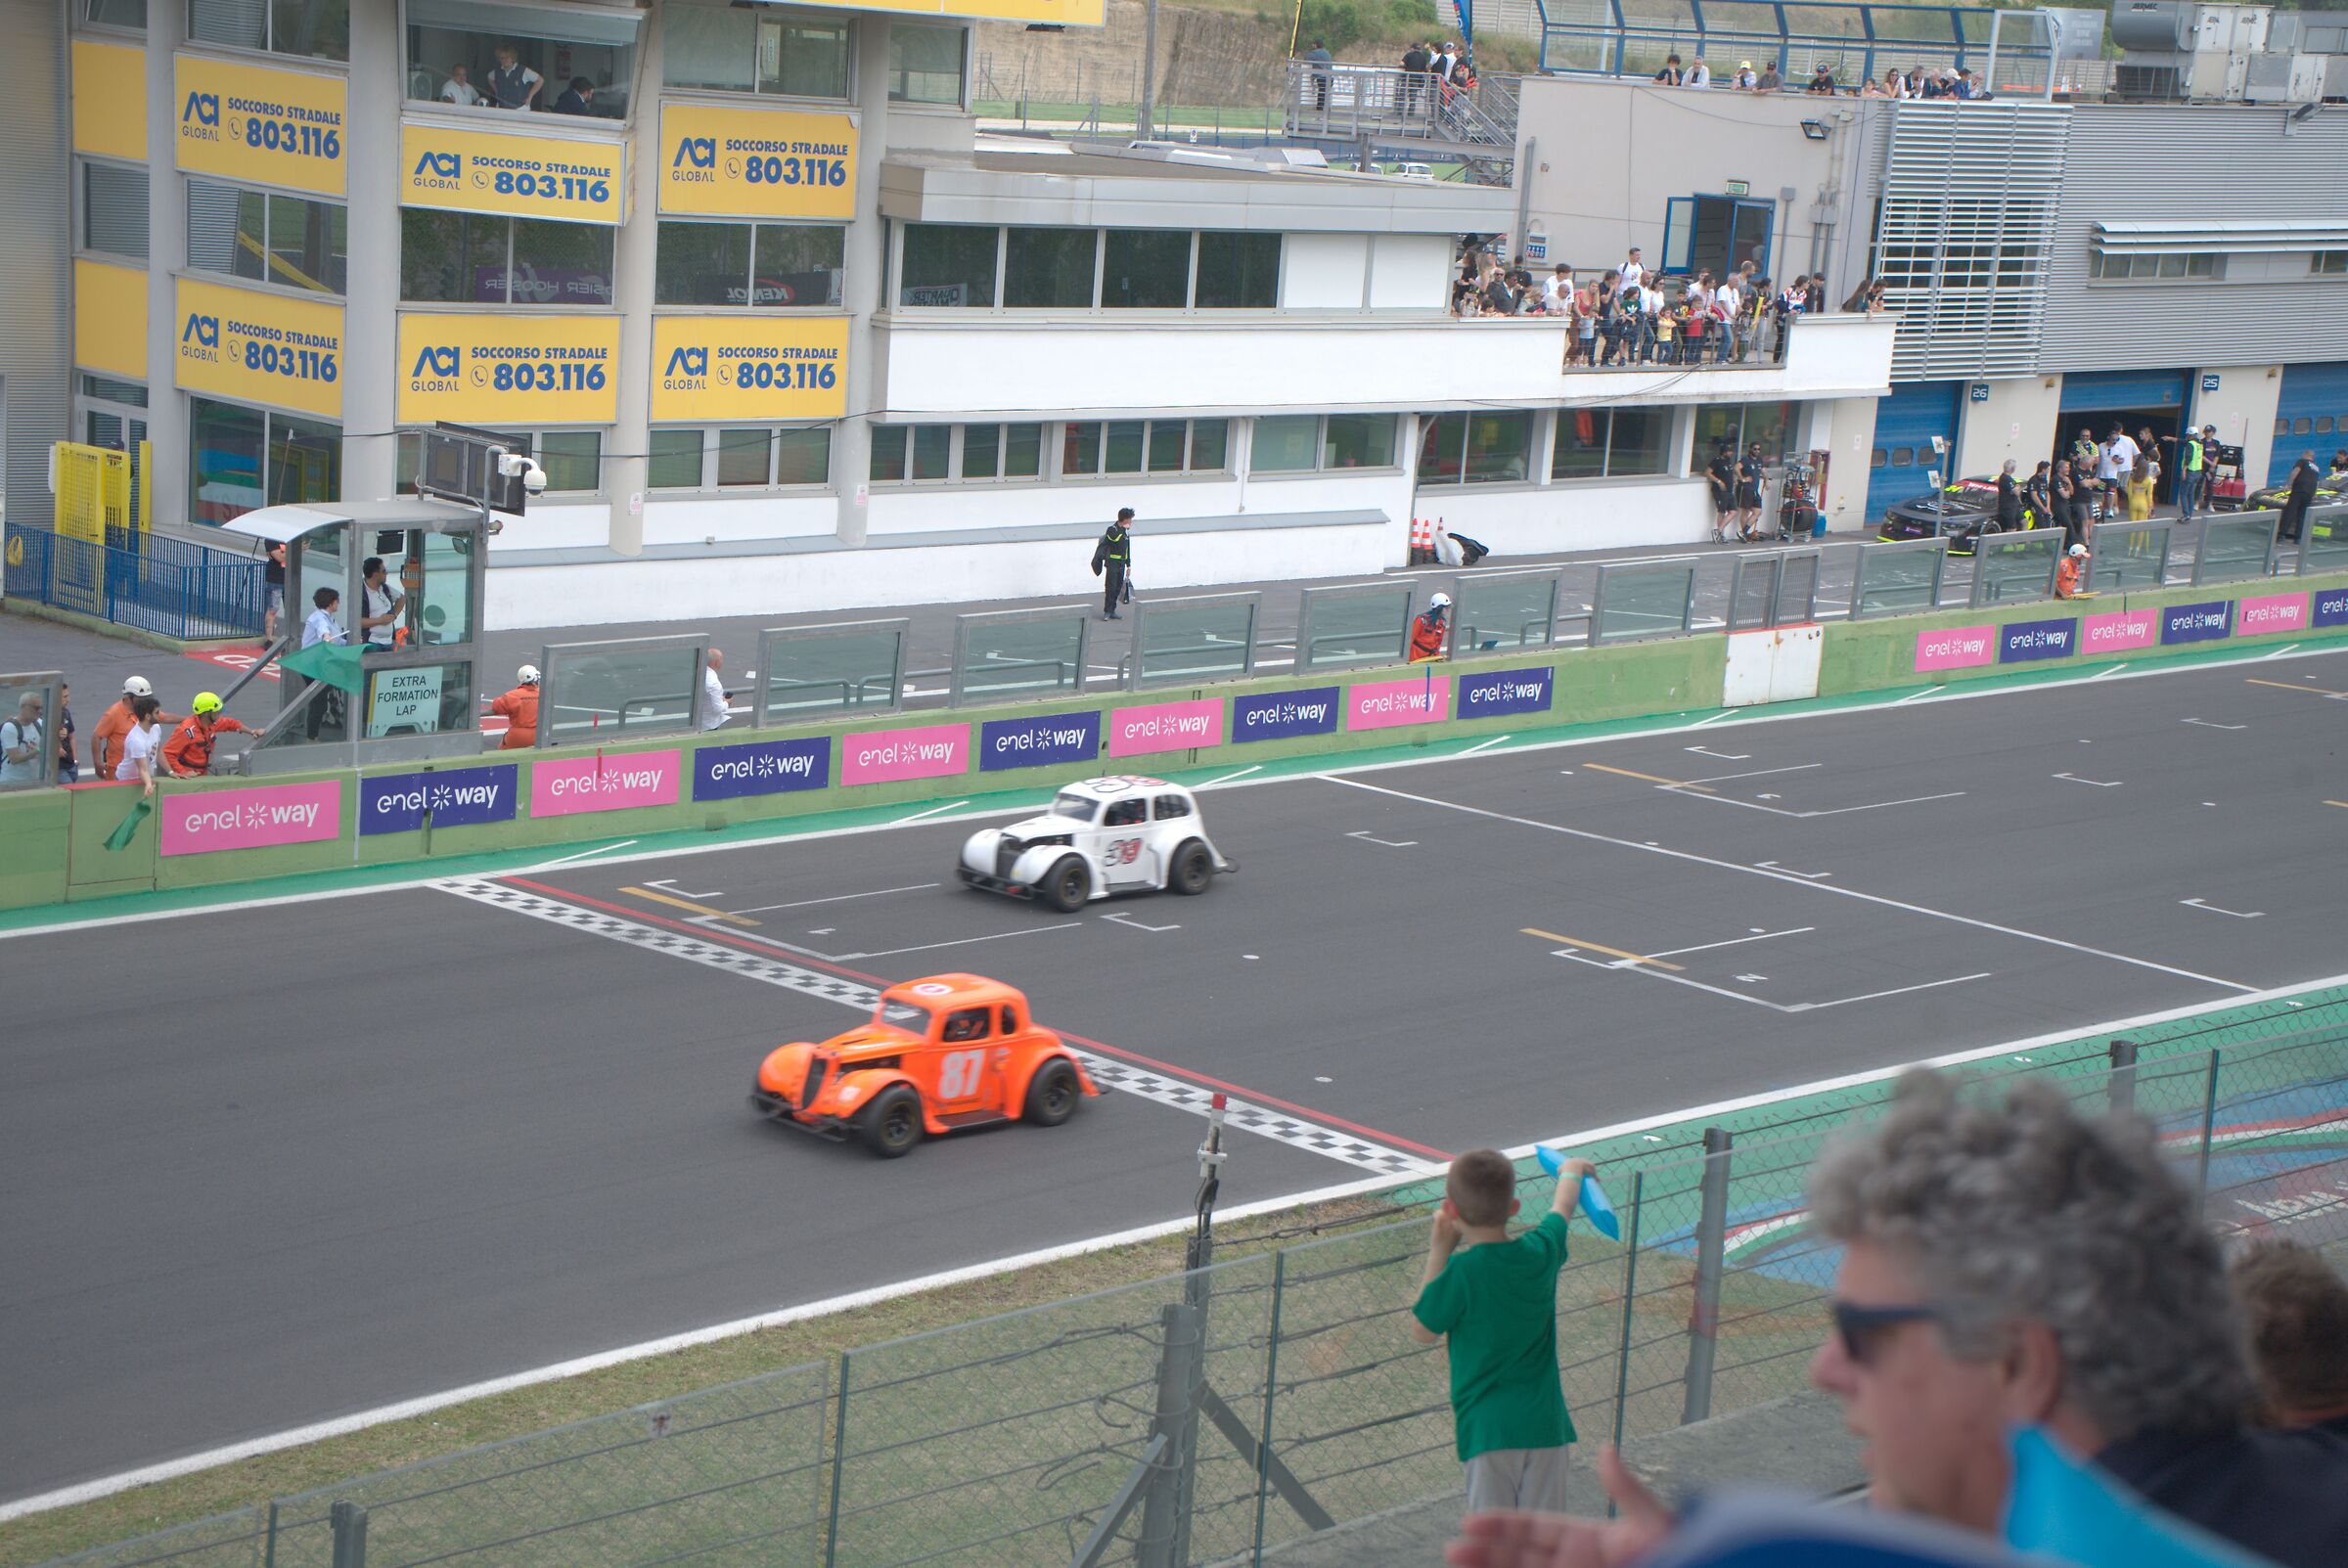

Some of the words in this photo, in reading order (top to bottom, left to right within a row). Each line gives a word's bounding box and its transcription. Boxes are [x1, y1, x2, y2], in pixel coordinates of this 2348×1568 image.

[227, 97, 284, 117] SOCCORSO
[287, 106, 340, 125] STRADALE
[182, 125, 220, 142] GLOBAL
[247, 117, 340, 159] 803.116
[726, 139, 788, 154] SOCCORSO
[790, 142, 848, 157] STRADALE
[472, 156, 541, 171] SOCCORSO
[546, 162, 610, 178] STRADALE
[672, 170, 715, 183] GLOBAL
[745, 156, 846, 187] 803.116
[413, 177, 461, 191] GLOBAL
[494, 171, 610, 203] 803.116
[227, 321, 282, 341] SOCCORSO
[286, 331, 338, 350] STRADALE
[181, 345, 219, 364] GLOBAL
[245, 340, 338, 383] 803.116
[472, 346, 541, 360] SOCCORSO
[544, 347, 608, 360] STRADALE
[717, 346, 779, 358] SOCCORSO
[783, 348, 838, 359] STRADALE
[493, 363, 607, 391] 803.116
[663, 380, 706, 390] GLOBAL
[737, 362, 835, 389] 803.116
[2203, 378, 2218, 387] 25
[411, 380, 460, 392] GLOBAL
[1972, 387, 1988, 398] 26
[2247, 605, 2270, 622] enel
[2280, 604, 2300, 620] way
[2323, 597, 2344, 614] enel
[2092, 622, 2115, 641] enel
[2126, 622, 2148, 639] way
[2171, 613, 2193, 631] enel
[2204, 612, 2225, 629] way
[1925, 639, 1951, 657] enel
[1963, 639, 1985, 655] way
[2009, 630, 2035, 650] enel
[2047, 630, 2068, 648] way
[391, 675, 427, 688] EXTRA
[377, 689, 438, 703] FORMATION
[1469, 683, 1501, 704] enel
[1515, 681, 1543, 702] way
[395, 704, 417, 716] LAP
[1361, 693, 1393, 714] enel
[1409, 693, 1437, 712] way
[1246, 704, 1280, 727] enel
[1297, 703, 1327, 724] way
[1125, 716, 1160, 739] enel
[1178, 714, 1210, 736] way
[996, 729, 1034, 753] enel
[1053, 728, 1086, 748] way
[858, 743, 898, 767] enel
[920, 741, 955, 763] way
[710, 755, 753, 781] enel
[777, 755, 814, 777] way
[551, 771, 597, 796] enel
[622, 769, 663, 792] way
[378, 786, 428, 814] enel
[454, 784, 499, 808] way
[185, 804, 241, 833] enel
[270, 802, 319, 828] way
[938, 1048, 987, 1099] 87
